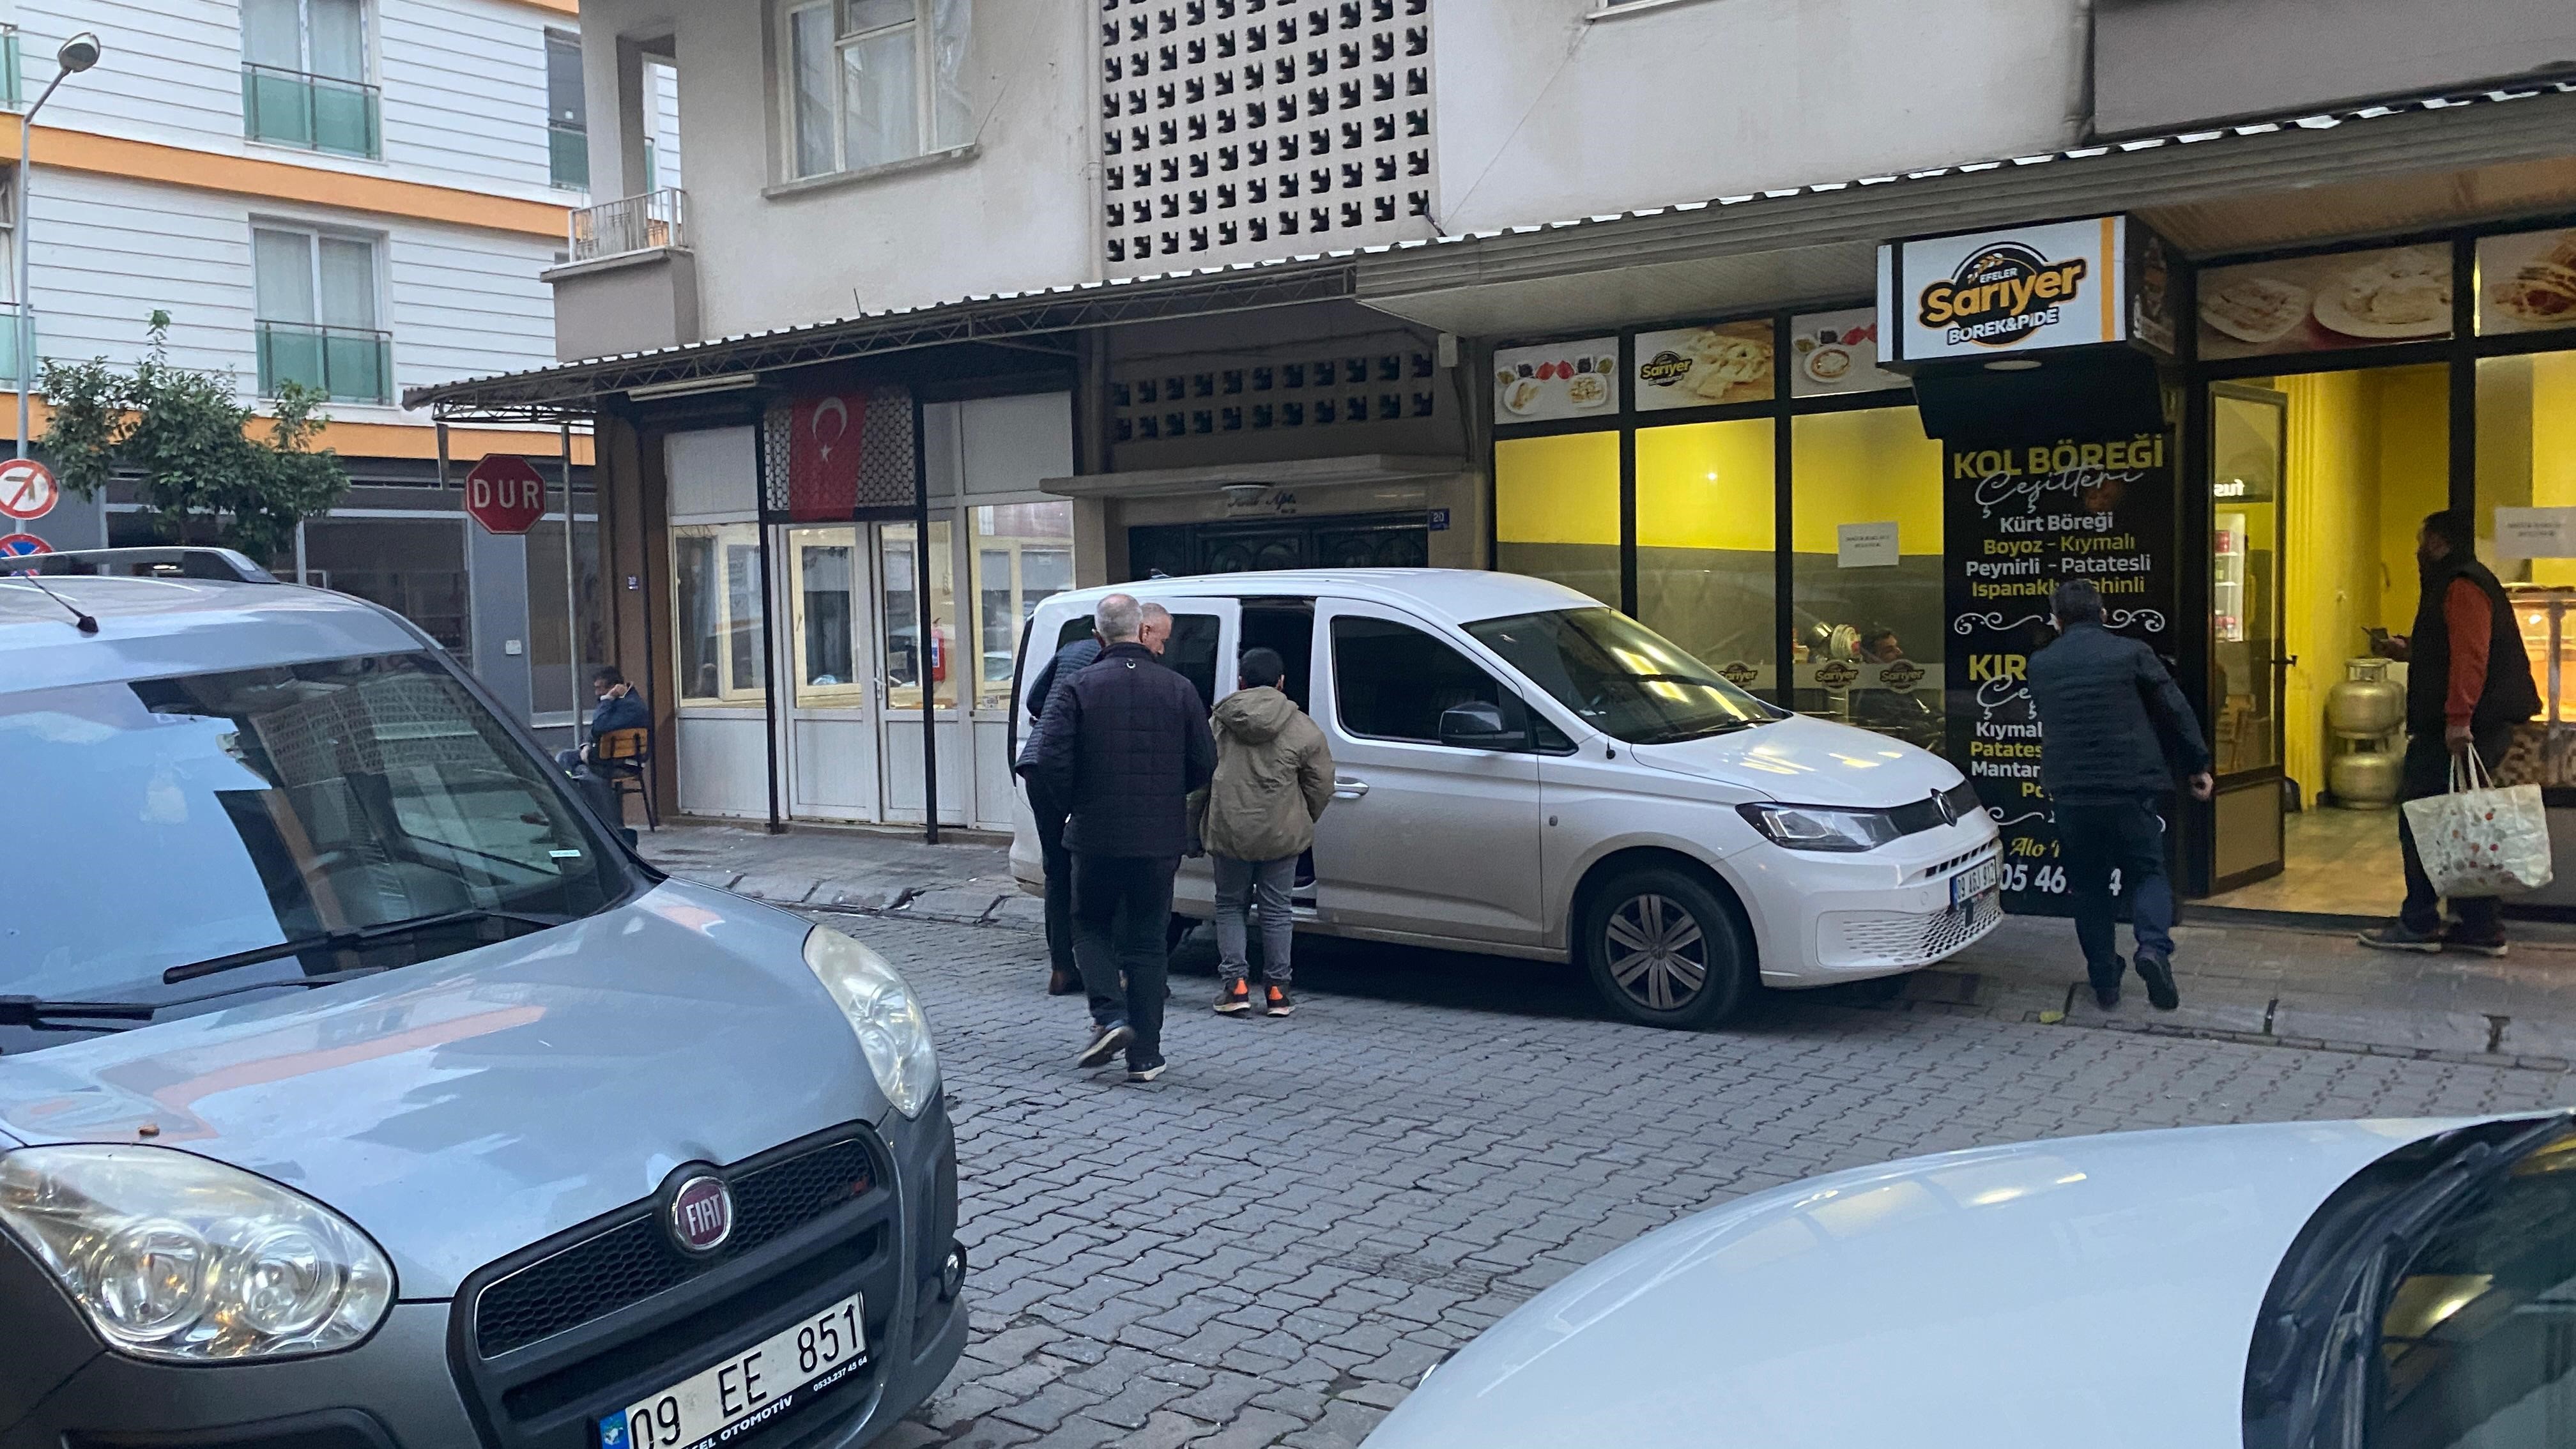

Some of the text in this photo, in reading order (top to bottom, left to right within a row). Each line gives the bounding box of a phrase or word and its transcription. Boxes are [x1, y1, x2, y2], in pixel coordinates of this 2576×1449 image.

[1981, 267, 2018, 284] EFELER
[1953, 433, 2164, 479] KOL BÖREĞİ
[473, 478, 540, 510] DUR
[1433, 512, 1445, 523] 20
[2000, 512, 2113, 533] Kürt Böreği
[1983, 539, 2044, 558] Boyoz
[2060, 533, 2136, 555] Kıymalı
[1966, 558, 2041, 579] Peynirli
[2061, 553, 2152, 574] Patatesli
[1972, 576, 2145, 599] Ispanakl ahinli
[1969, 654, 2027, 681] KIR
[2034, 865, 2067, 894] 46
[686, 1193, 722, 1236] FIAT
[630, 1303, 859, 1449] 09 EE 851
[720, 1395, 793, 1441] OTOMOTİV
